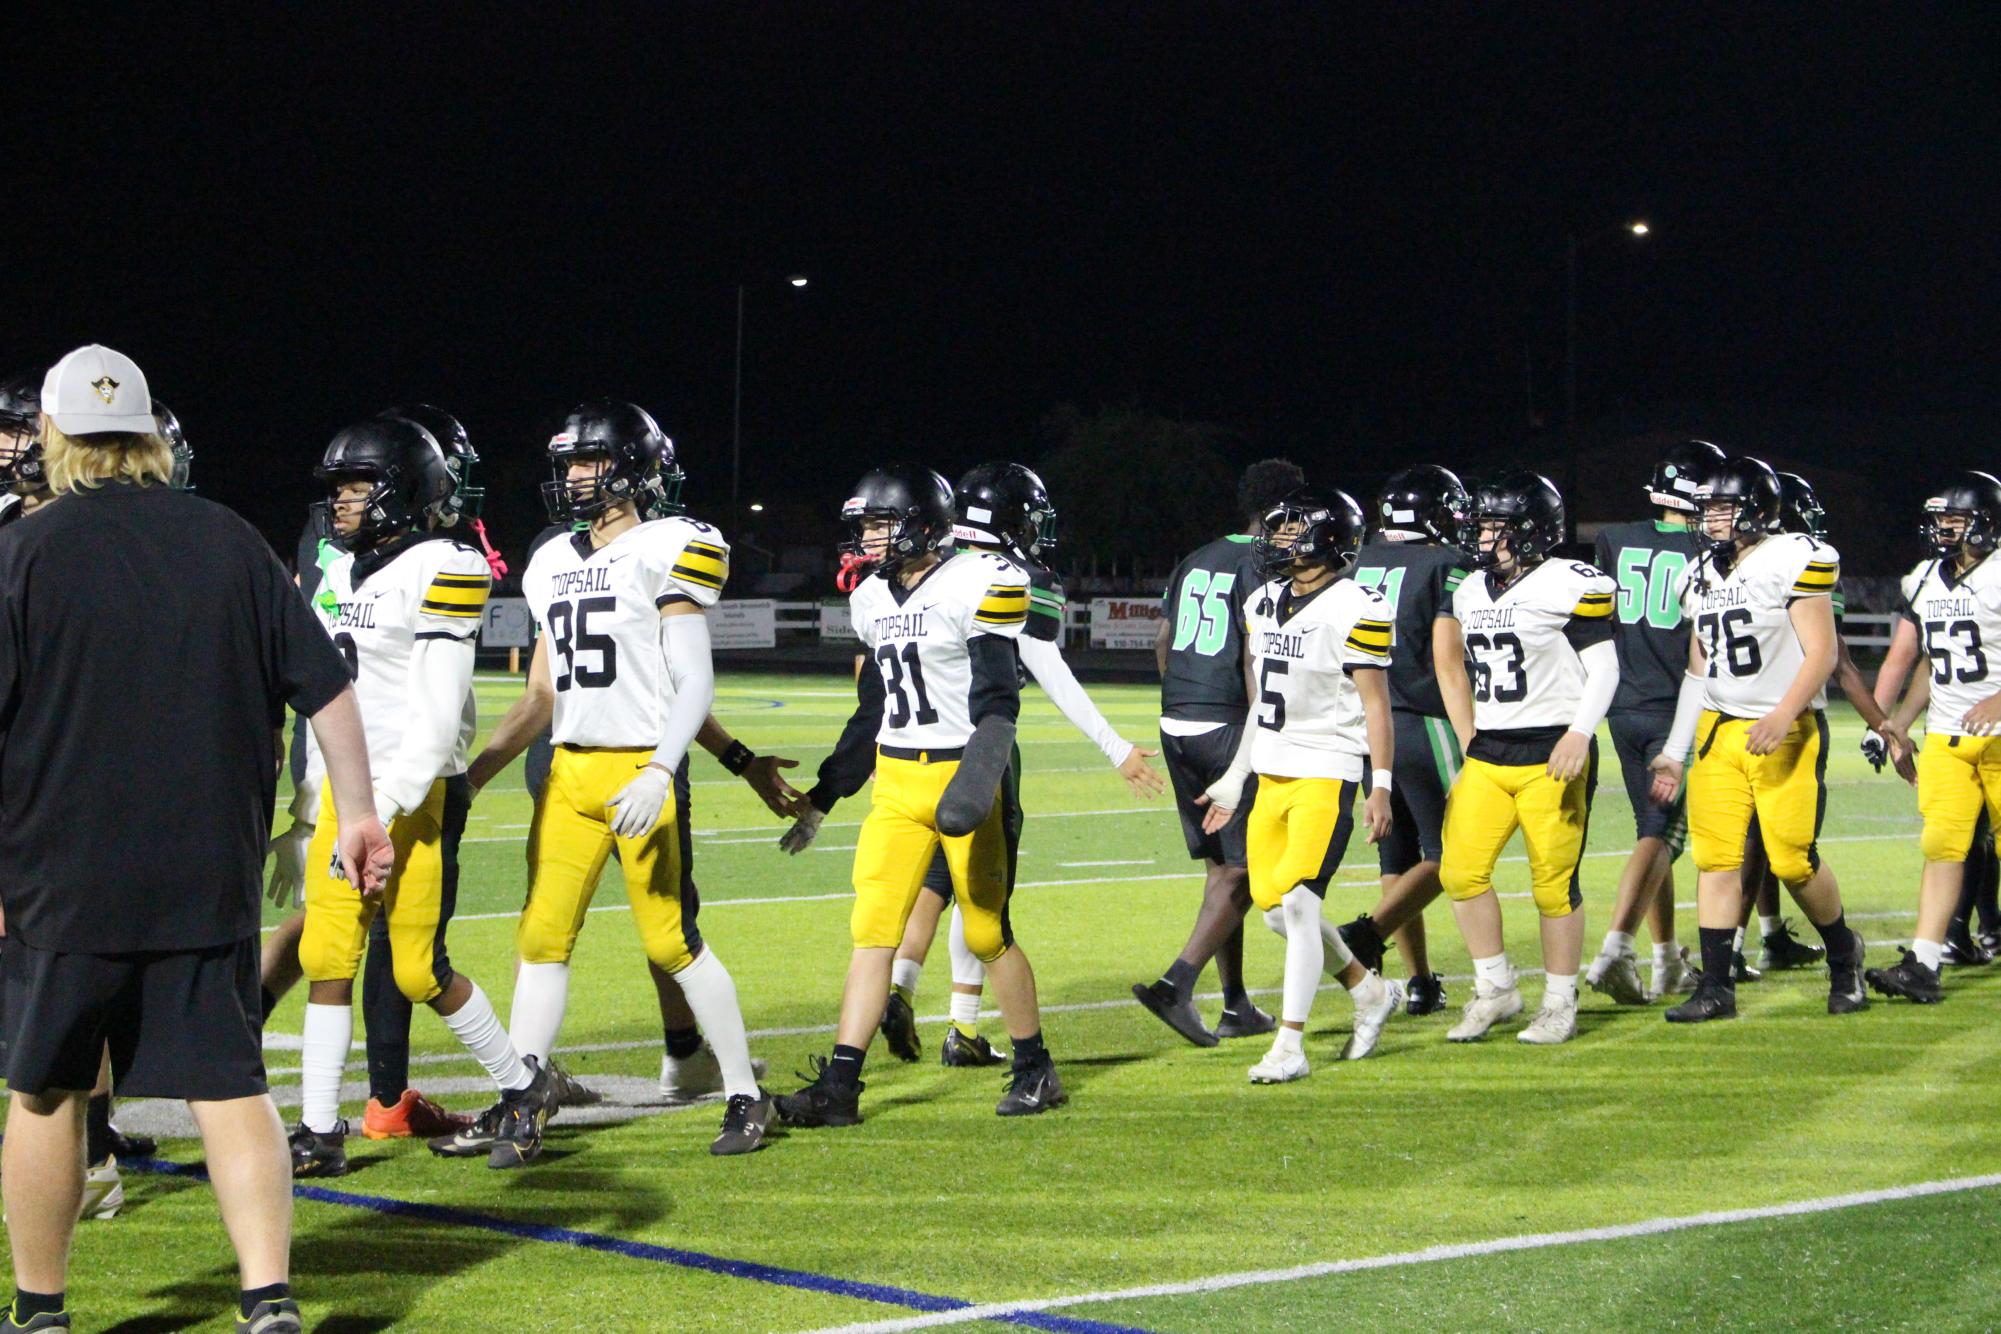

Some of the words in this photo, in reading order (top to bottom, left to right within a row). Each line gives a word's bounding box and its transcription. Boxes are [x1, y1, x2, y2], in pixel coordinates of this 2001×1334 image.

[552, 567, 611, 598] TOPSAIL
[1172, 567, 1237, 657] 65
[1617, 547, 1690, 630] 50
[1926, 598, 1974, 618] TOPSAIL
[328, 603, 376, 631] PSAIL
[547, 596, 617, 692] 85
[875, 613, 928, 641] TOPSAIL
[1261, 630, 1305, 659] TOPSAIL
[1468, 607, 1516, 630] TOPSAIL
[1698, 607, 1762, 678] 76
[876, 641, 940, 729] 31
[1466, 632, 1528, 703] 63
[1925, 619, 1989, 685] 53
[1257, 657, 1289, 733] 5
